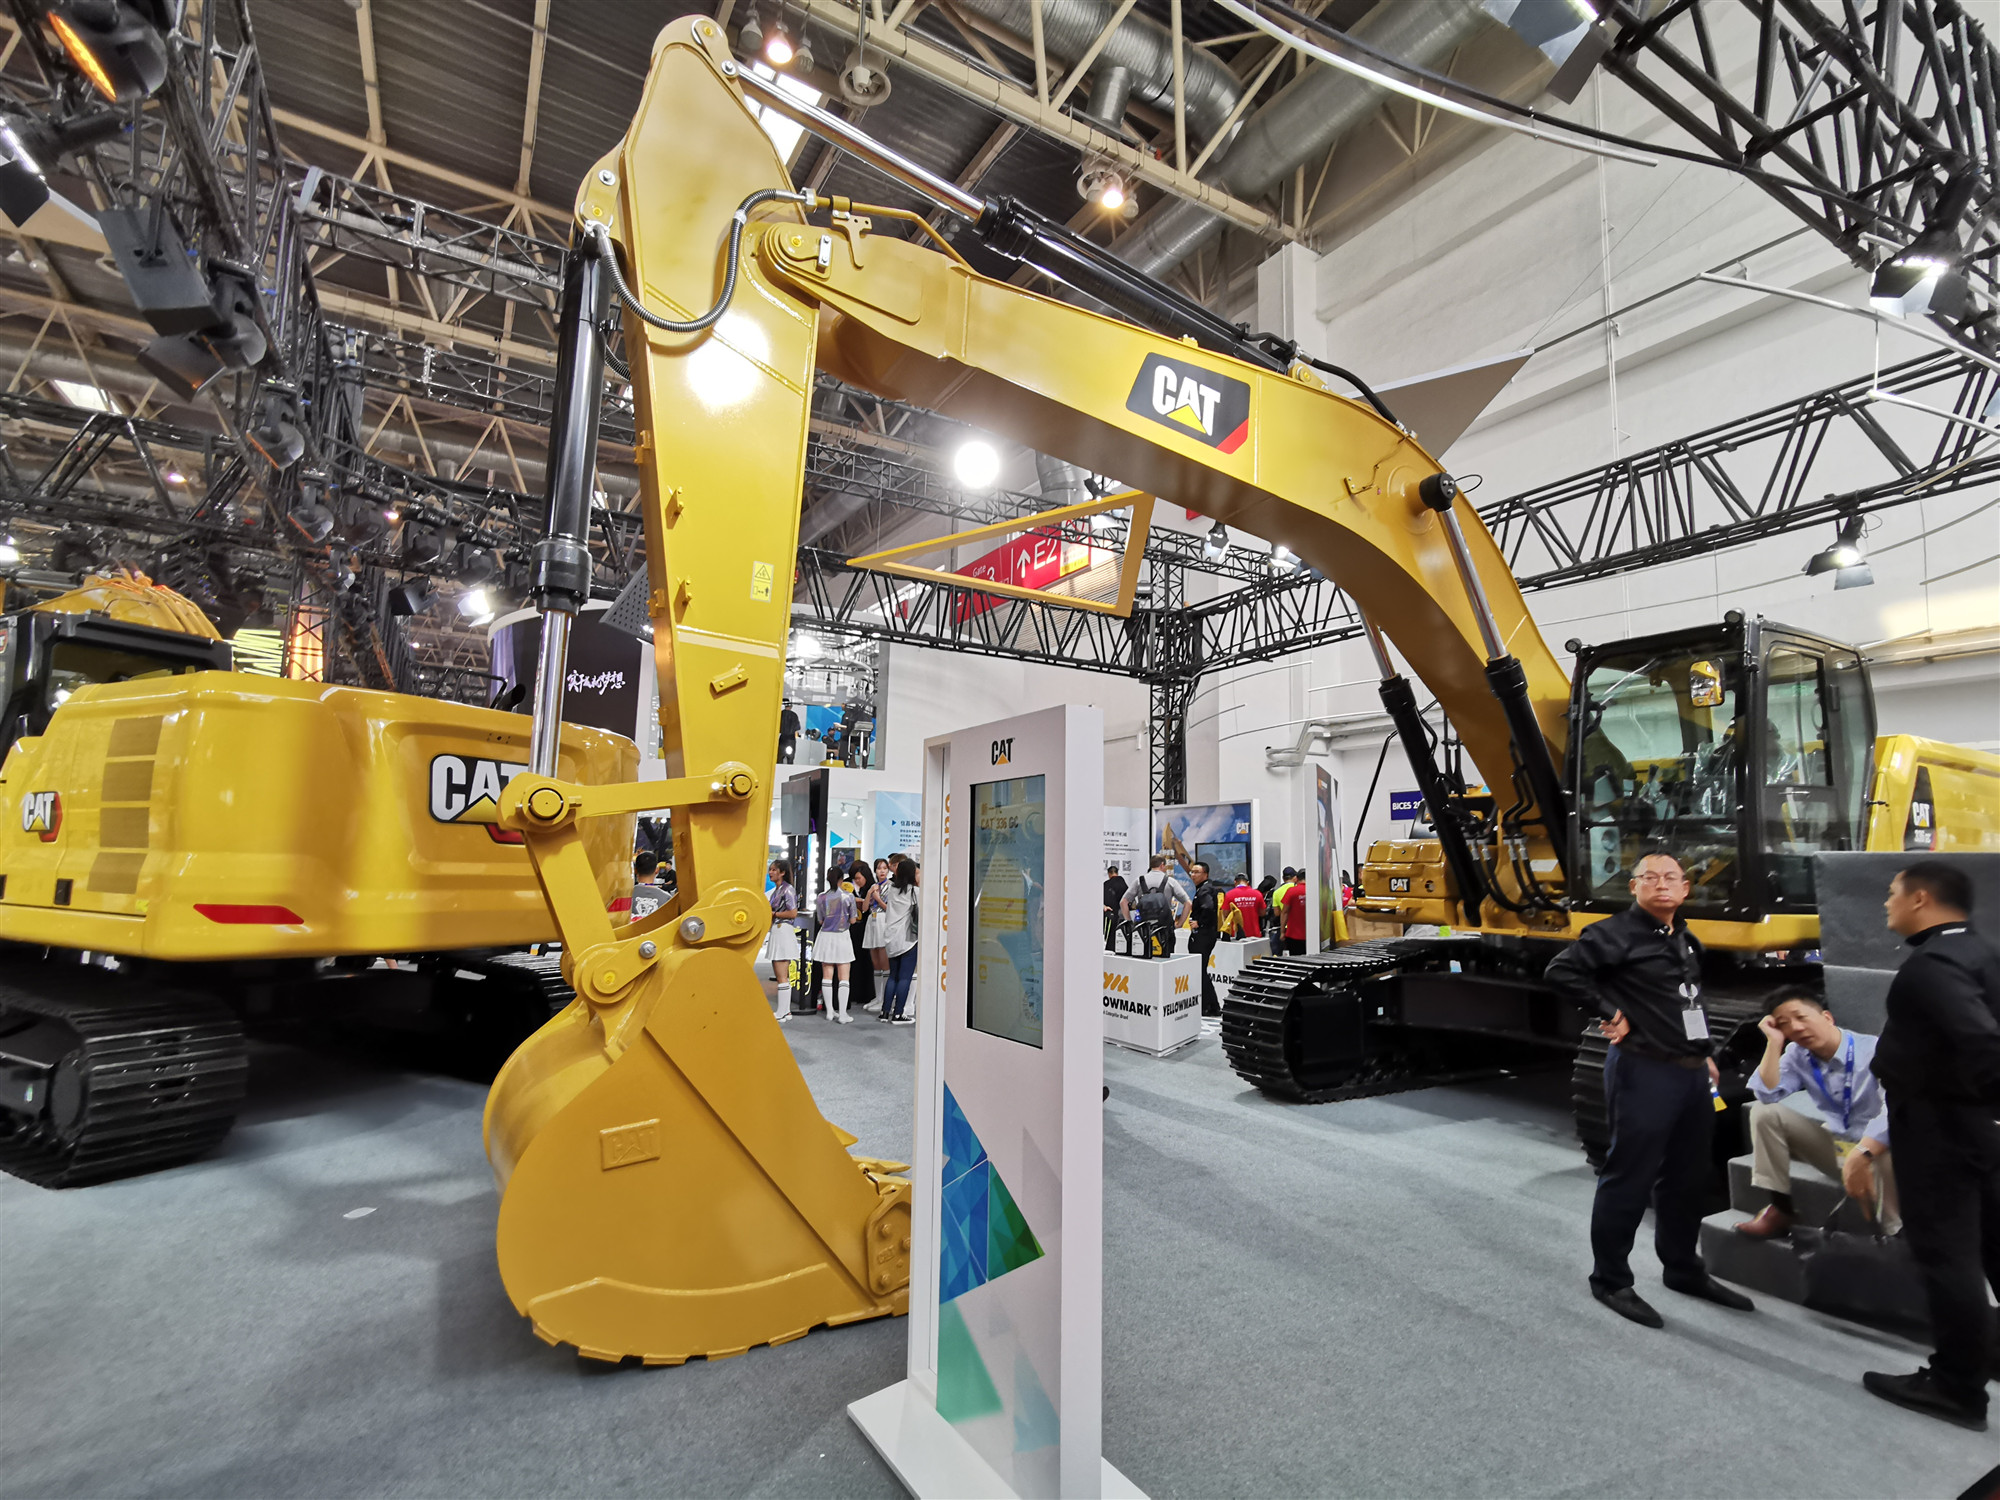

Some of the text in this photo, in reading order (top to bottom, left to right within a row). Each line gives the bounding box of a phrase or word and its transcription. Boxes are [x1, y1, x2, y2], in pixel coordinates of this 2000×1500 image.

[1152, 365, 1221, 437] CAT
[1034, 538, 1058, 570] E2
[972, 564, 987, 578] Gate
[991, 737, 1014, 765] CAT
[23, 792, 56, 831] CAT
[1392, 801, 1412, 811] BICES
[1912, 801, 1930, 828] CAT
[1236, 822, 1250, 834] CAT
[1391, 878, 1408, 891] CAT
[1162, 994, 1200, 1018] YELLOWMARK
[608, 1126, 655, 1164] CAT
